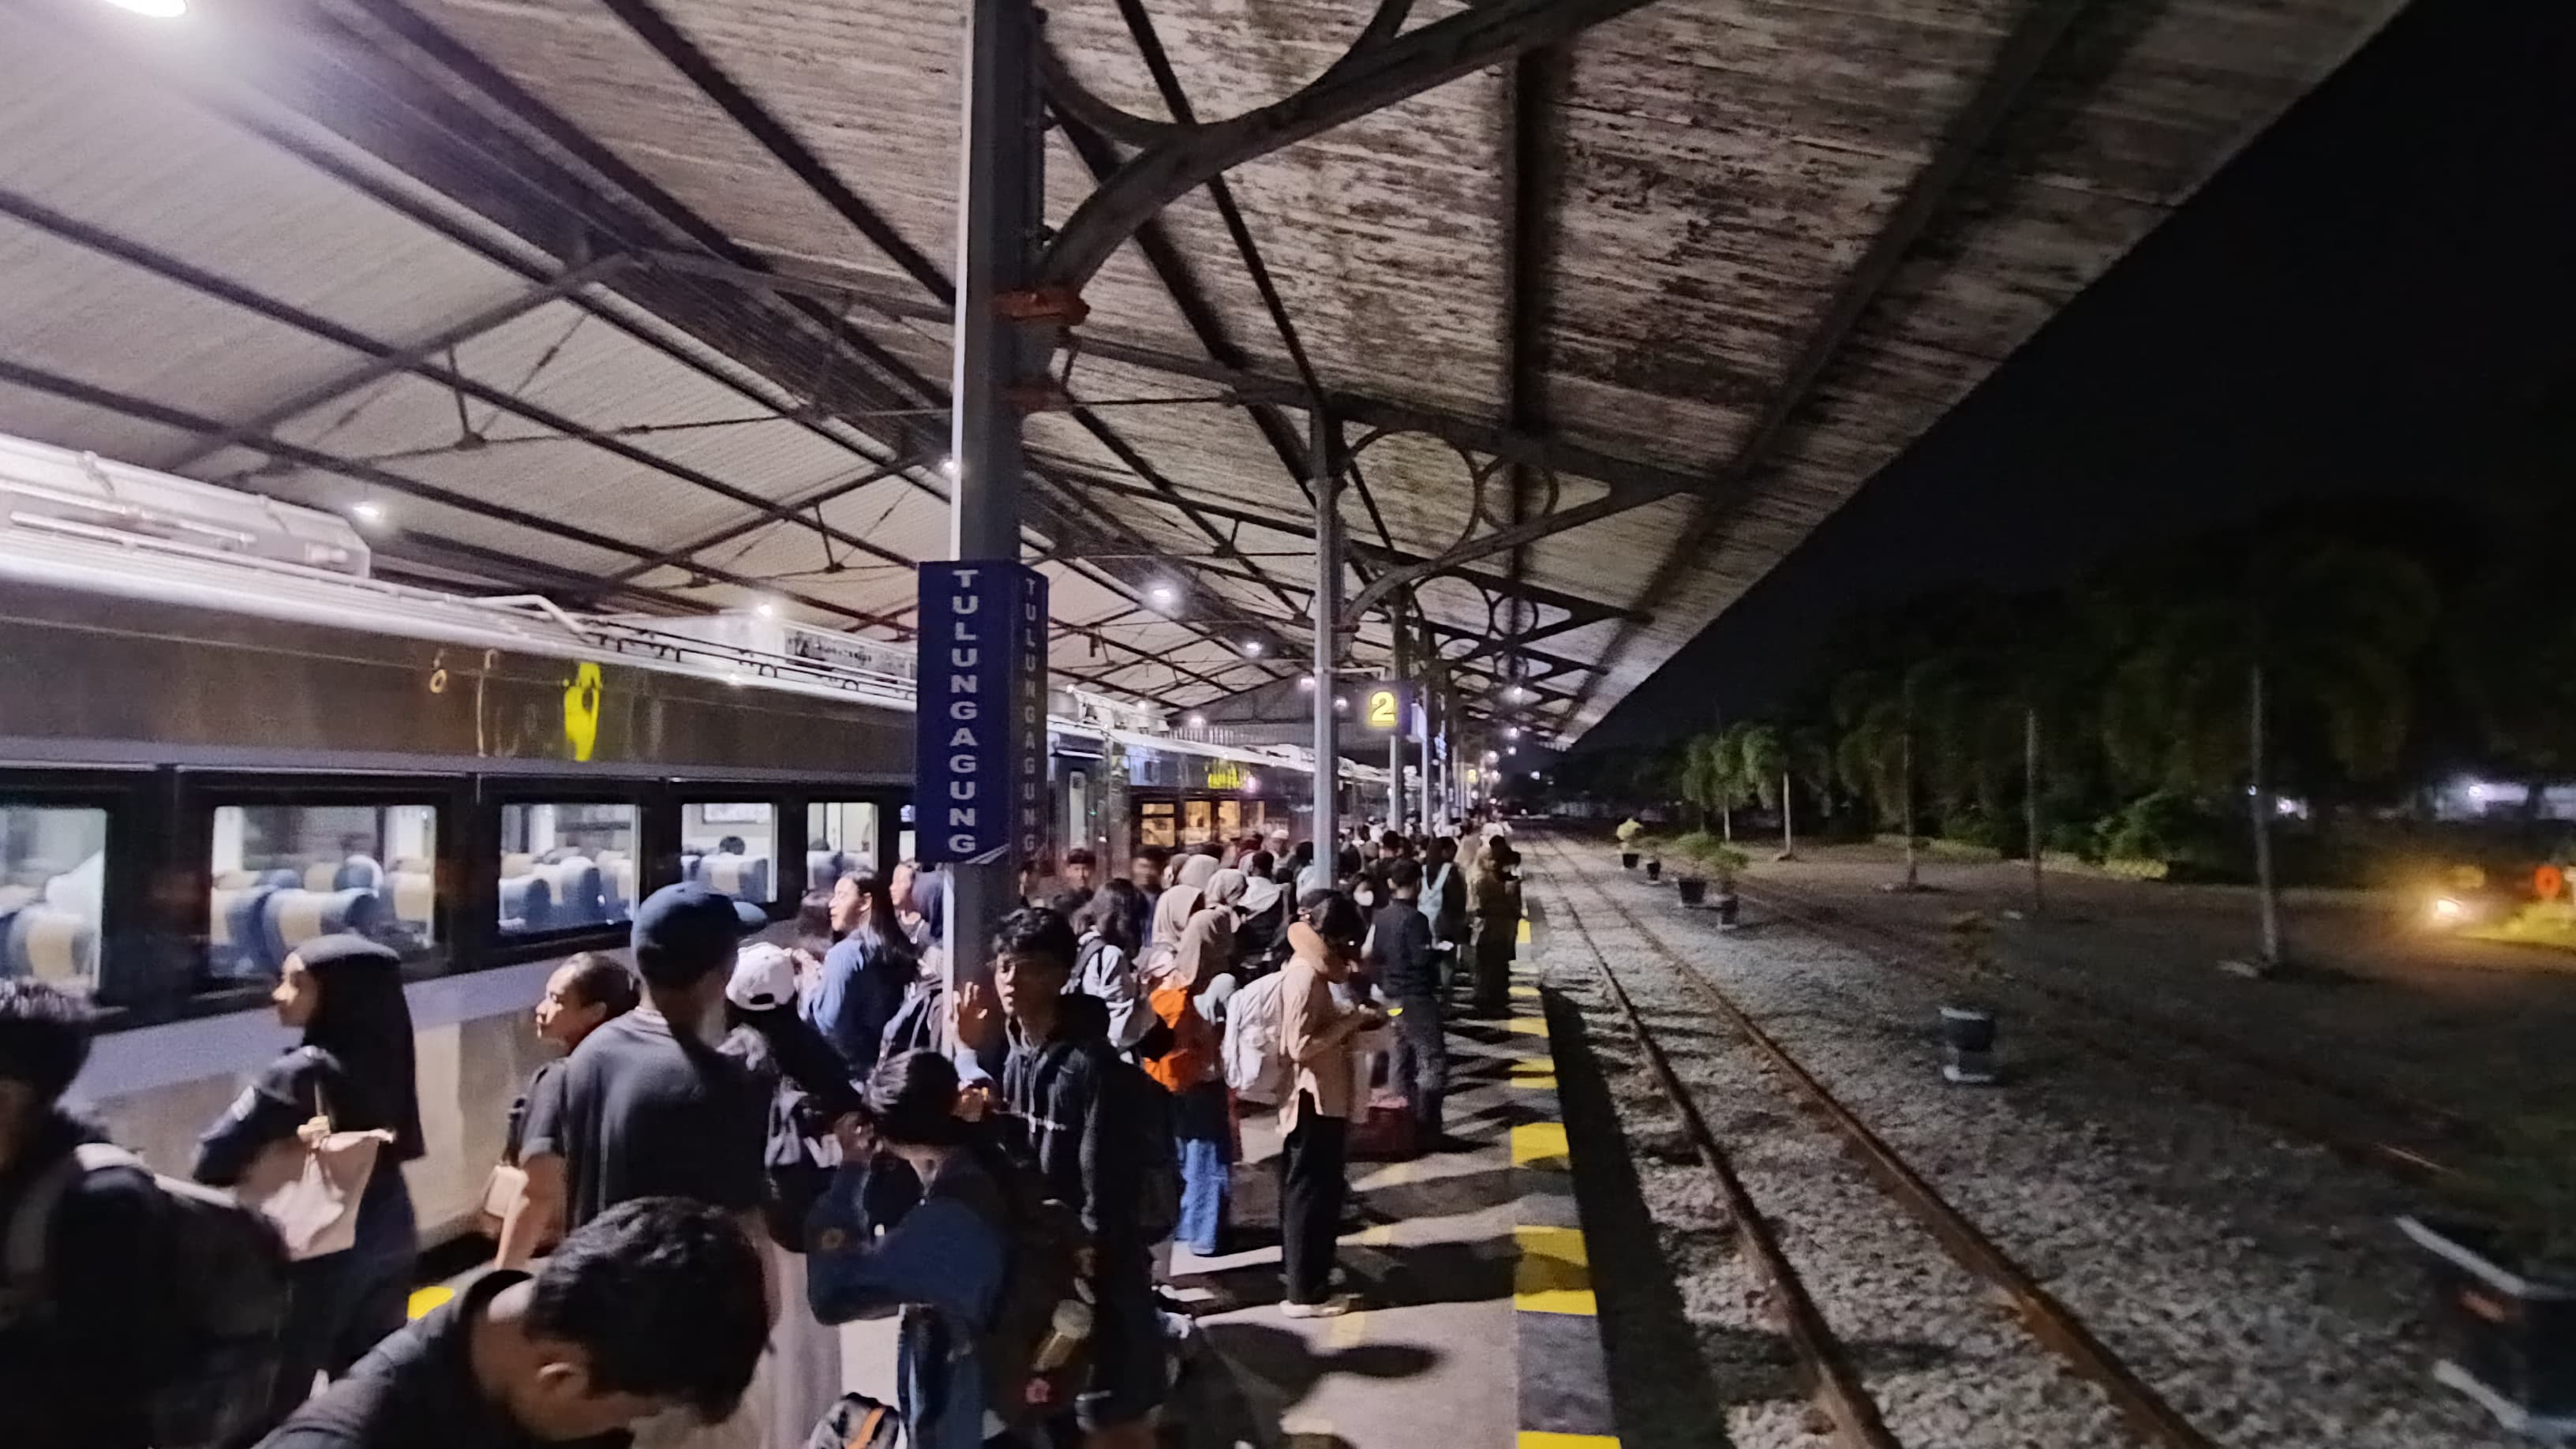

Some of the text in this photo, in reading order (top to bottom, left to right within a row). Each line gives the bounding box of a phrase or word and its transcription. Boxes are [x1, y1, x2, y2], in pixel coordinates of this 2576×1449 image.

[949, 569, 979, 853] TULUNGAGUNG
[1023, 578, 1036, 852] TULUNGAGUNG
[1371, 691, 1396, 726] 2
